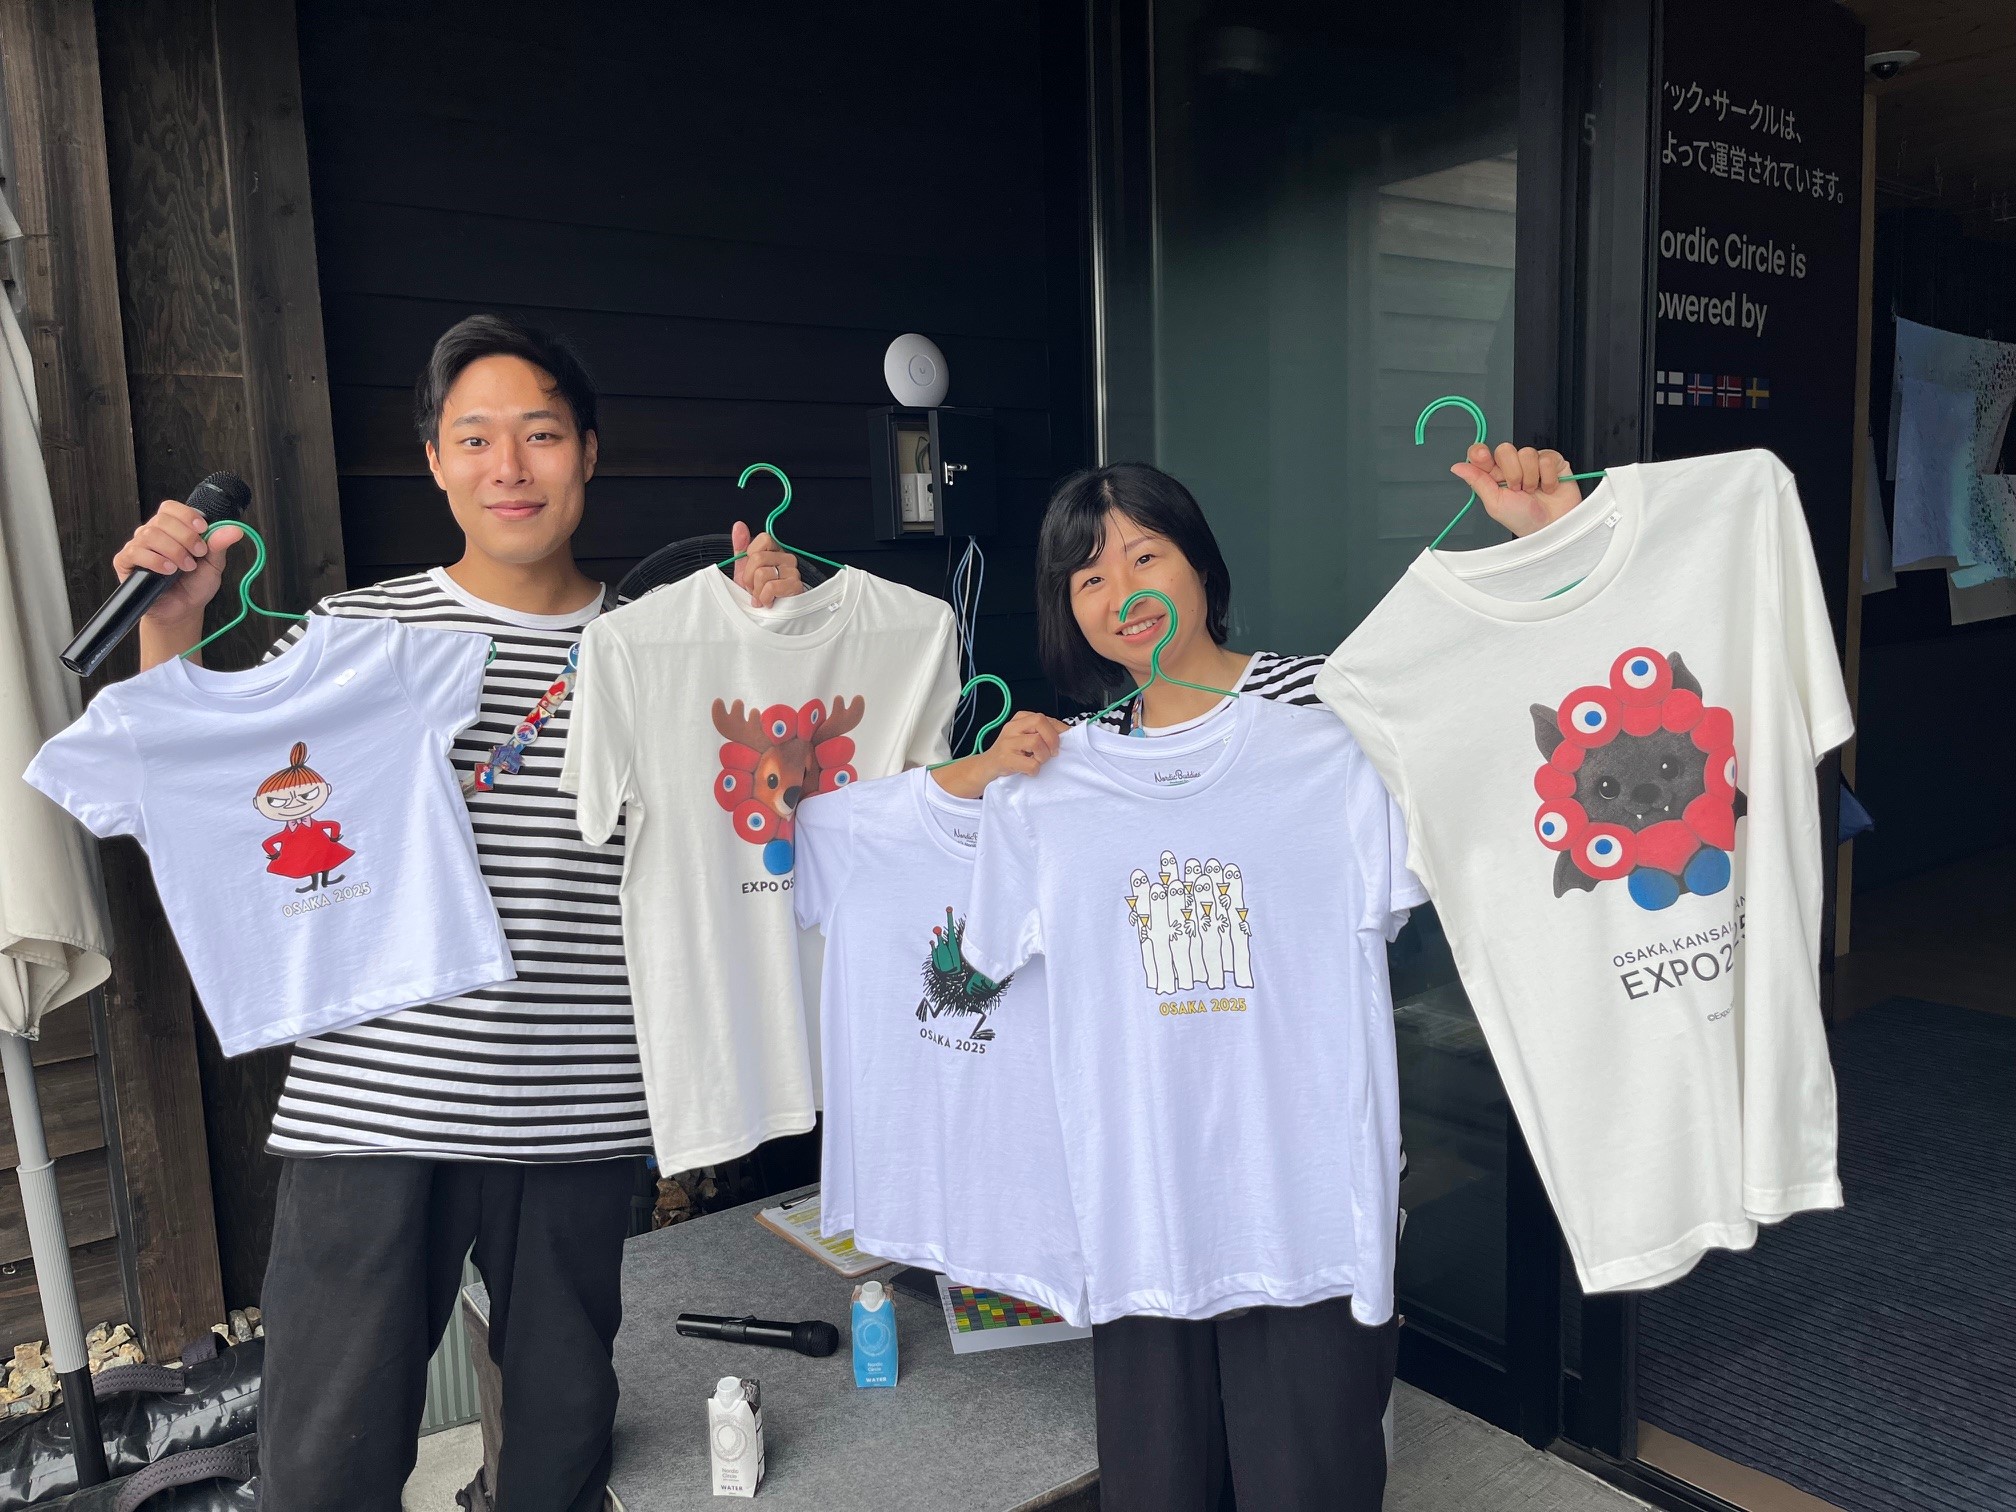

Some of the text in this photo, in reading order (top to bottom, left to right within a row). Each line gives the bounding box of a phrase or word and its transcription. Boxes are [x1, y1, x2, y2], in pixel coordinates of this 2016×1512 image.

[1661, 130, 1844, 204] よって運営されています。
[1724, 233, 1786, 276] Circle
[1790, 242, 1807, 280] is
[1741, 293, 1768, 338] by
[282, 881, 372, 917] OSAKA 2025
[741, 881, 779, 894] EXPO
[1159, 997, 1247, 1017] OSAKA 2025
[920, 1028, 986, 1054] OSAKA 2025
